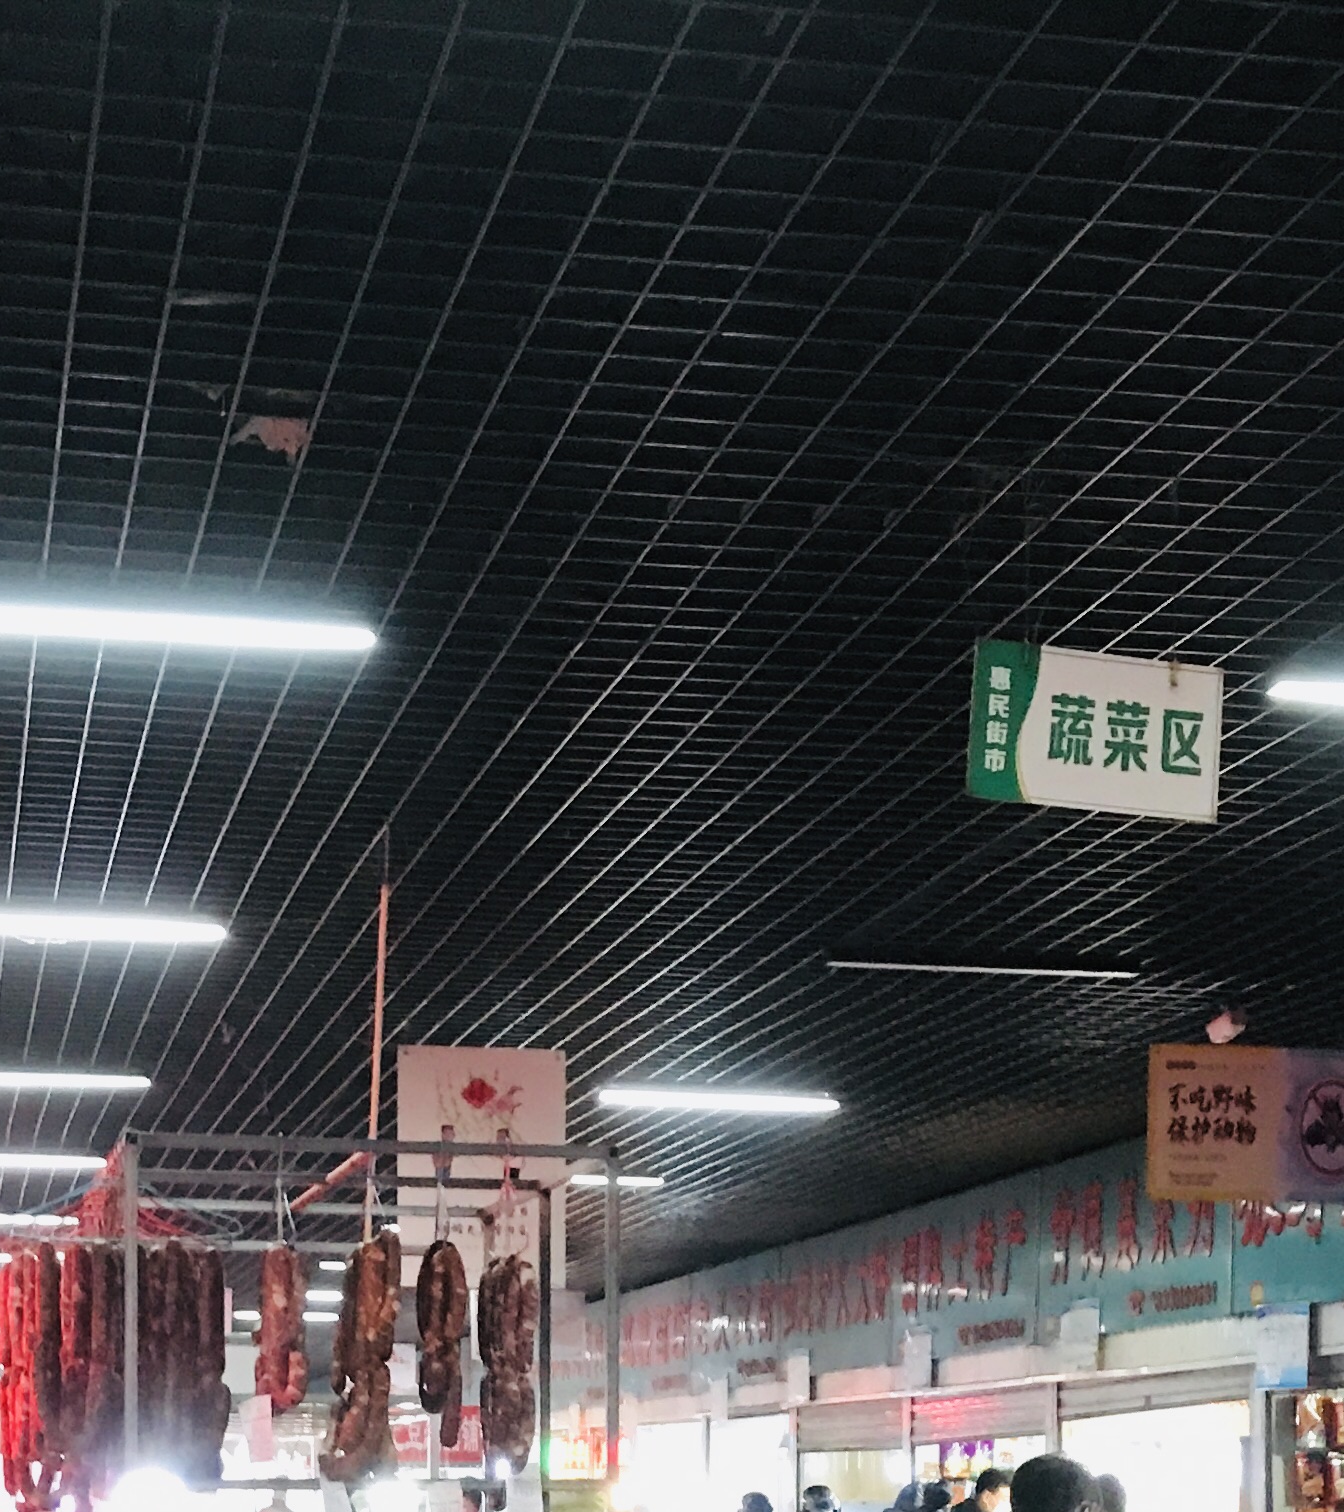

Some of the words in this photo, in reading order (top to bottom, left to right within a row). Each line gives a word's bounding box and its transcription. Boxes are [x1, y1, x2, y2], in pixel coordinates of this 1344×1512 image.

[984, 666, 1011, 773] 惠民街市
[1048, 693, 1204, 777] 蔬菜区
[1168, 1083, 1257, 1115] 不吃野味
[1167, 1115, 1257, 1145] 保护动物
